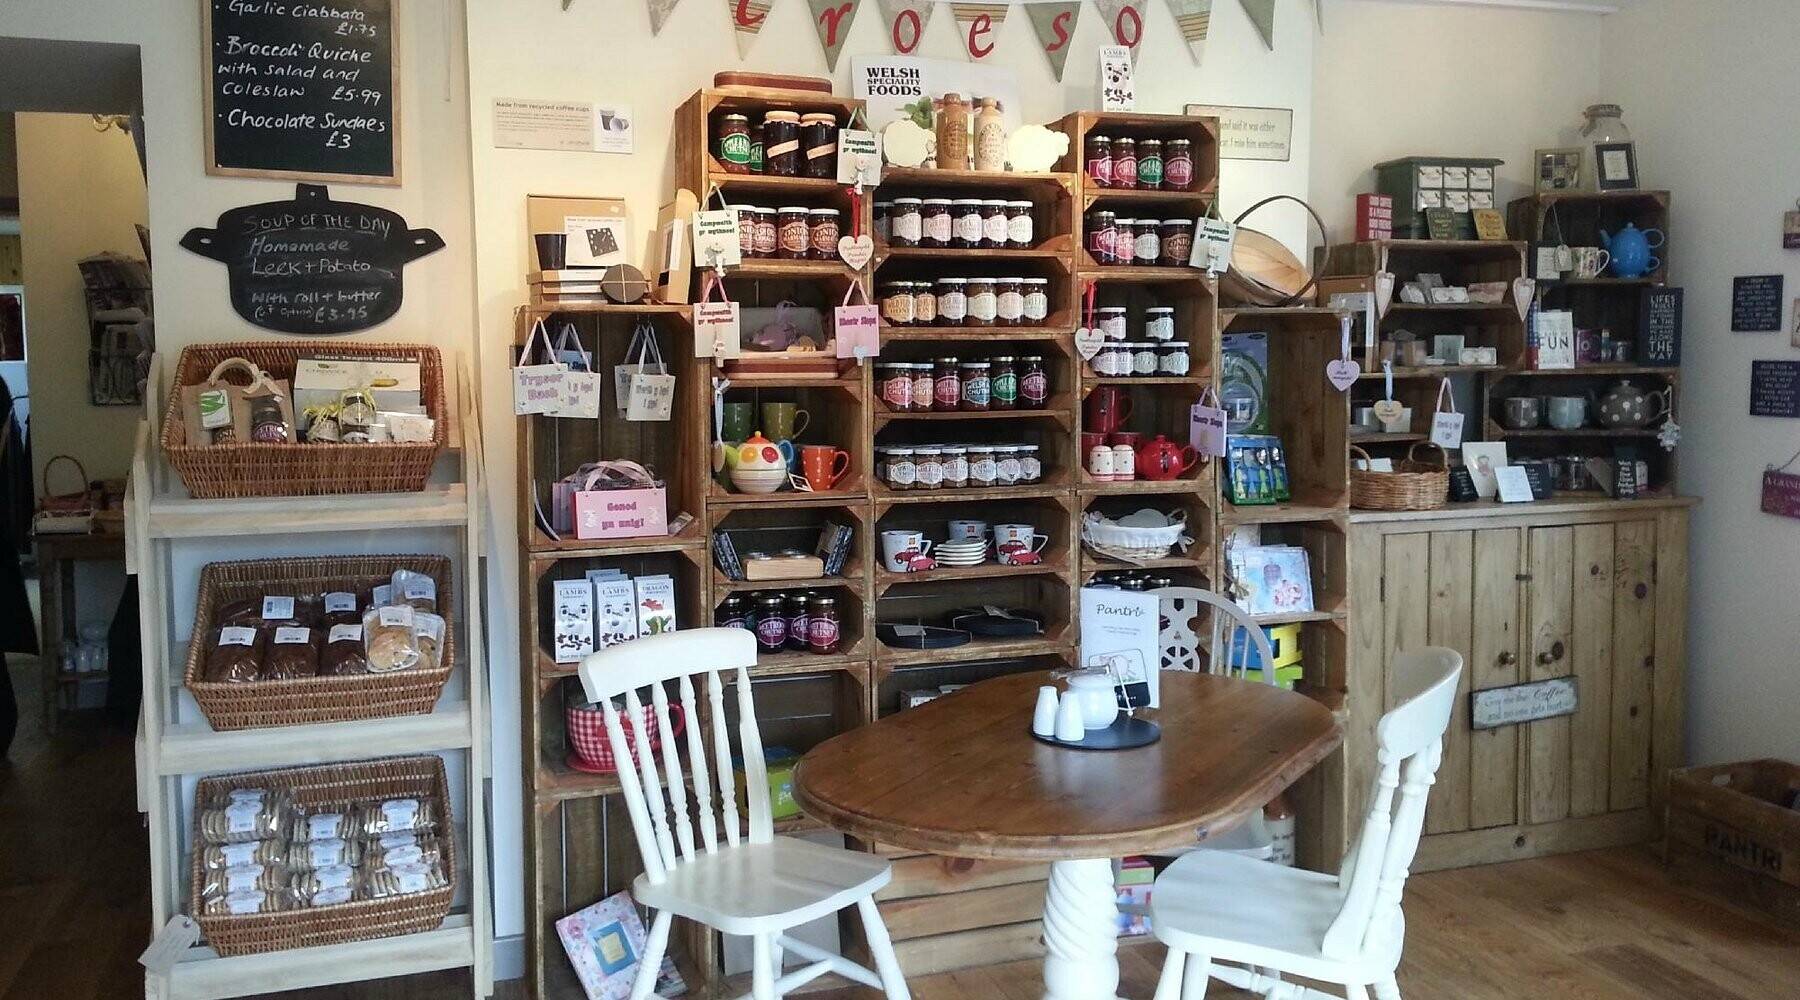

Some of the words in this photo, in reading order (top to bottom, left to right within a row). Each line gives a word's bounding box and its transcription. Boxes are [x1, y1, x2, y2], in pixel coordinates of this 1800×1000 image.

[335, 22, 376, 37] £1.75
[308, 42, 372, 63] Quiche
[218, 63, 259, 76] with
[264, 64, 317, 79] salad
[322, 68, 361, 82] and
[867, 67, 920, 79] WELSH
[867, 78, 921, 86] SPECIALITY
[331, 86, 382, 107] £5.99
[868, 85, 922, 96] FOODS
[228, 108, 316, 130] Chocolate
[320, 112, 386, 133] Sundaes
[326, 131, 351, 149] £3
[244, 213, 295, 232] SOUP
[301, 213, 318, 226] OF
[323, 214, 353, 227] THE
[360, 214, 391, 240] DAY
[319, 259, 371, 272] Potato
[1538, 336, 1569, 350] FUN
[1650, 341, 1673, 351] THE
[1649, 351, 1673, 361] WAY
[1096, 603, 1141, 617] Pantri
